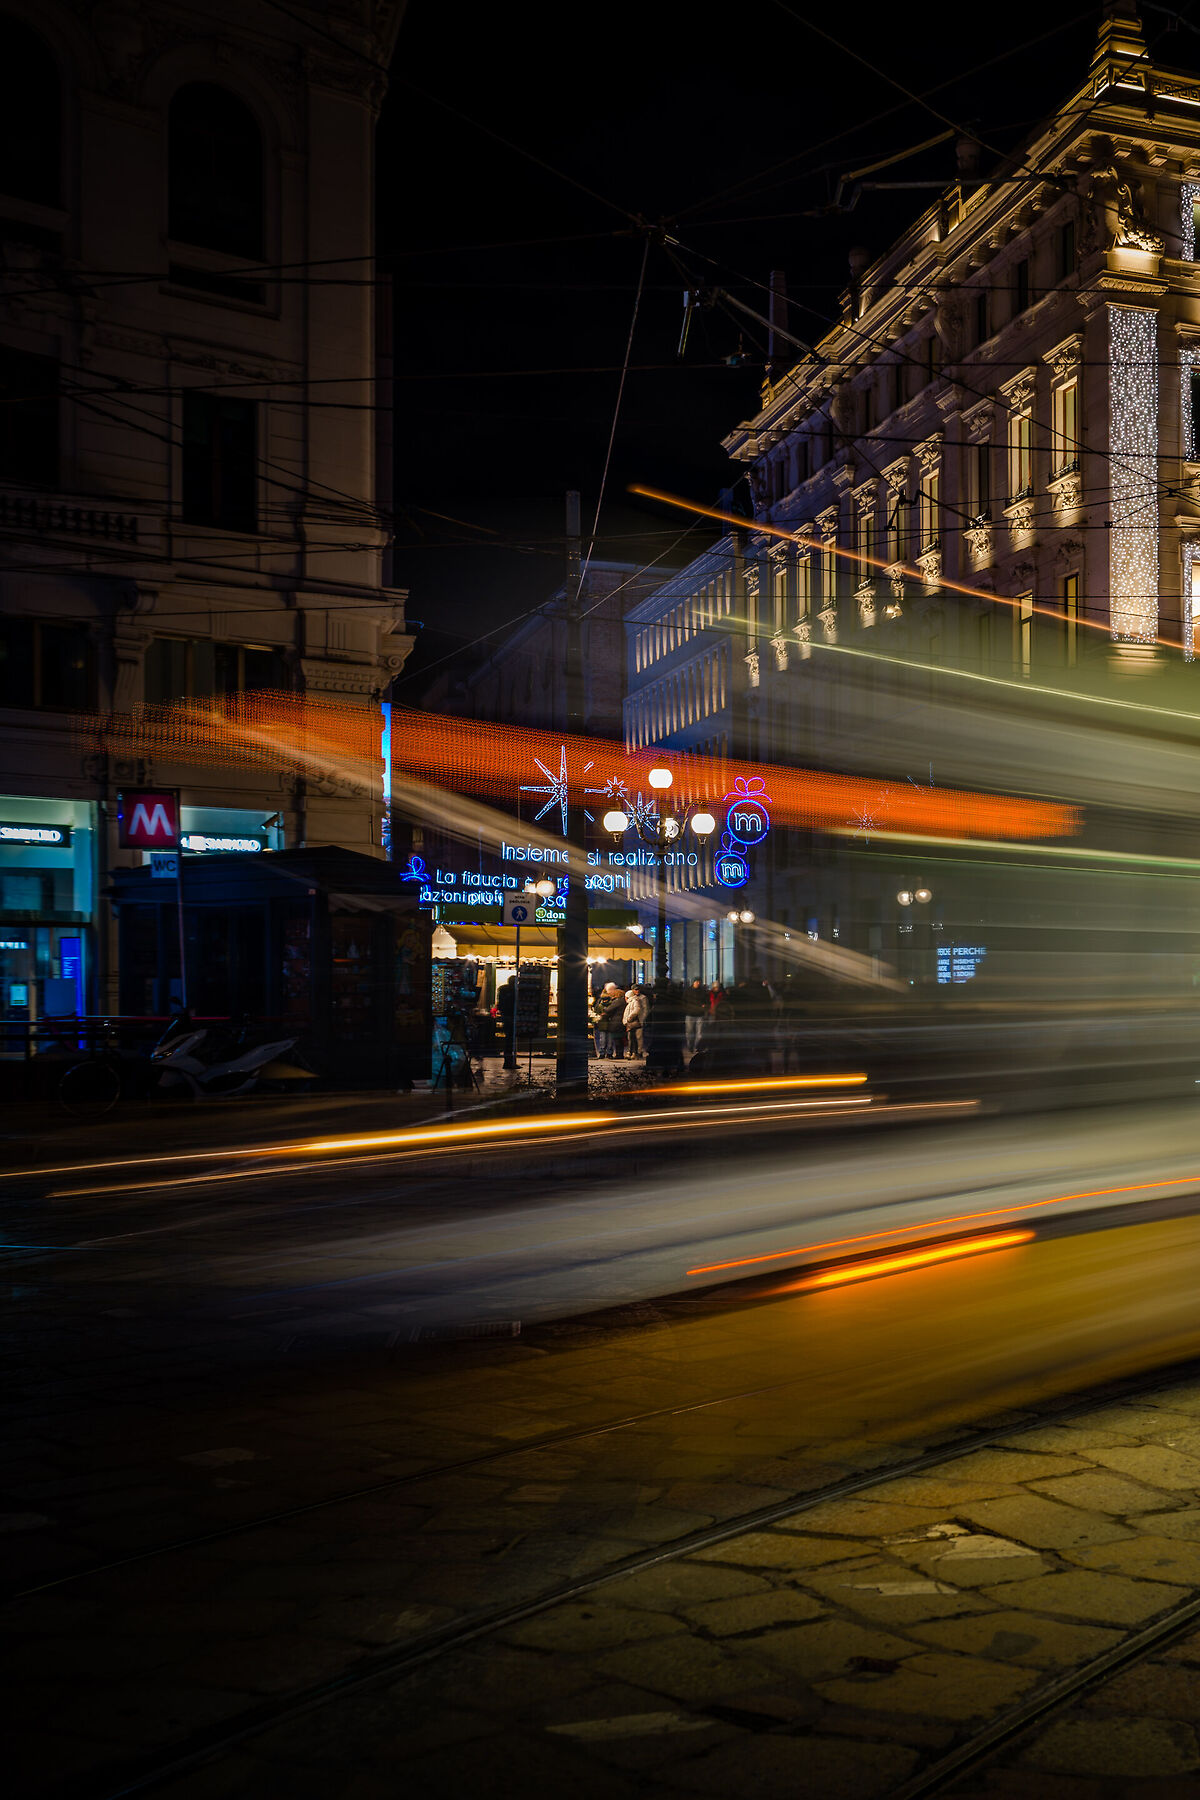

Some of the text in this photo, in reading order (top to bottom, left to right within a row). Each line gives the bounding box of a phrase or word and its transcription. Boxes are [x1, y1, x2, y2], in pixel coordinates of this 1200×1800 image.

[129, 803, 174, 836] M
[734, 812, 762, 832] m
[502, 842, 569, 863] Insieme
[608, 848, 698, 866] realizano
[153, 859, 176, 872] WC
[436, 869, 455, 885] La
[462, 871, 518, 889] fiducia
